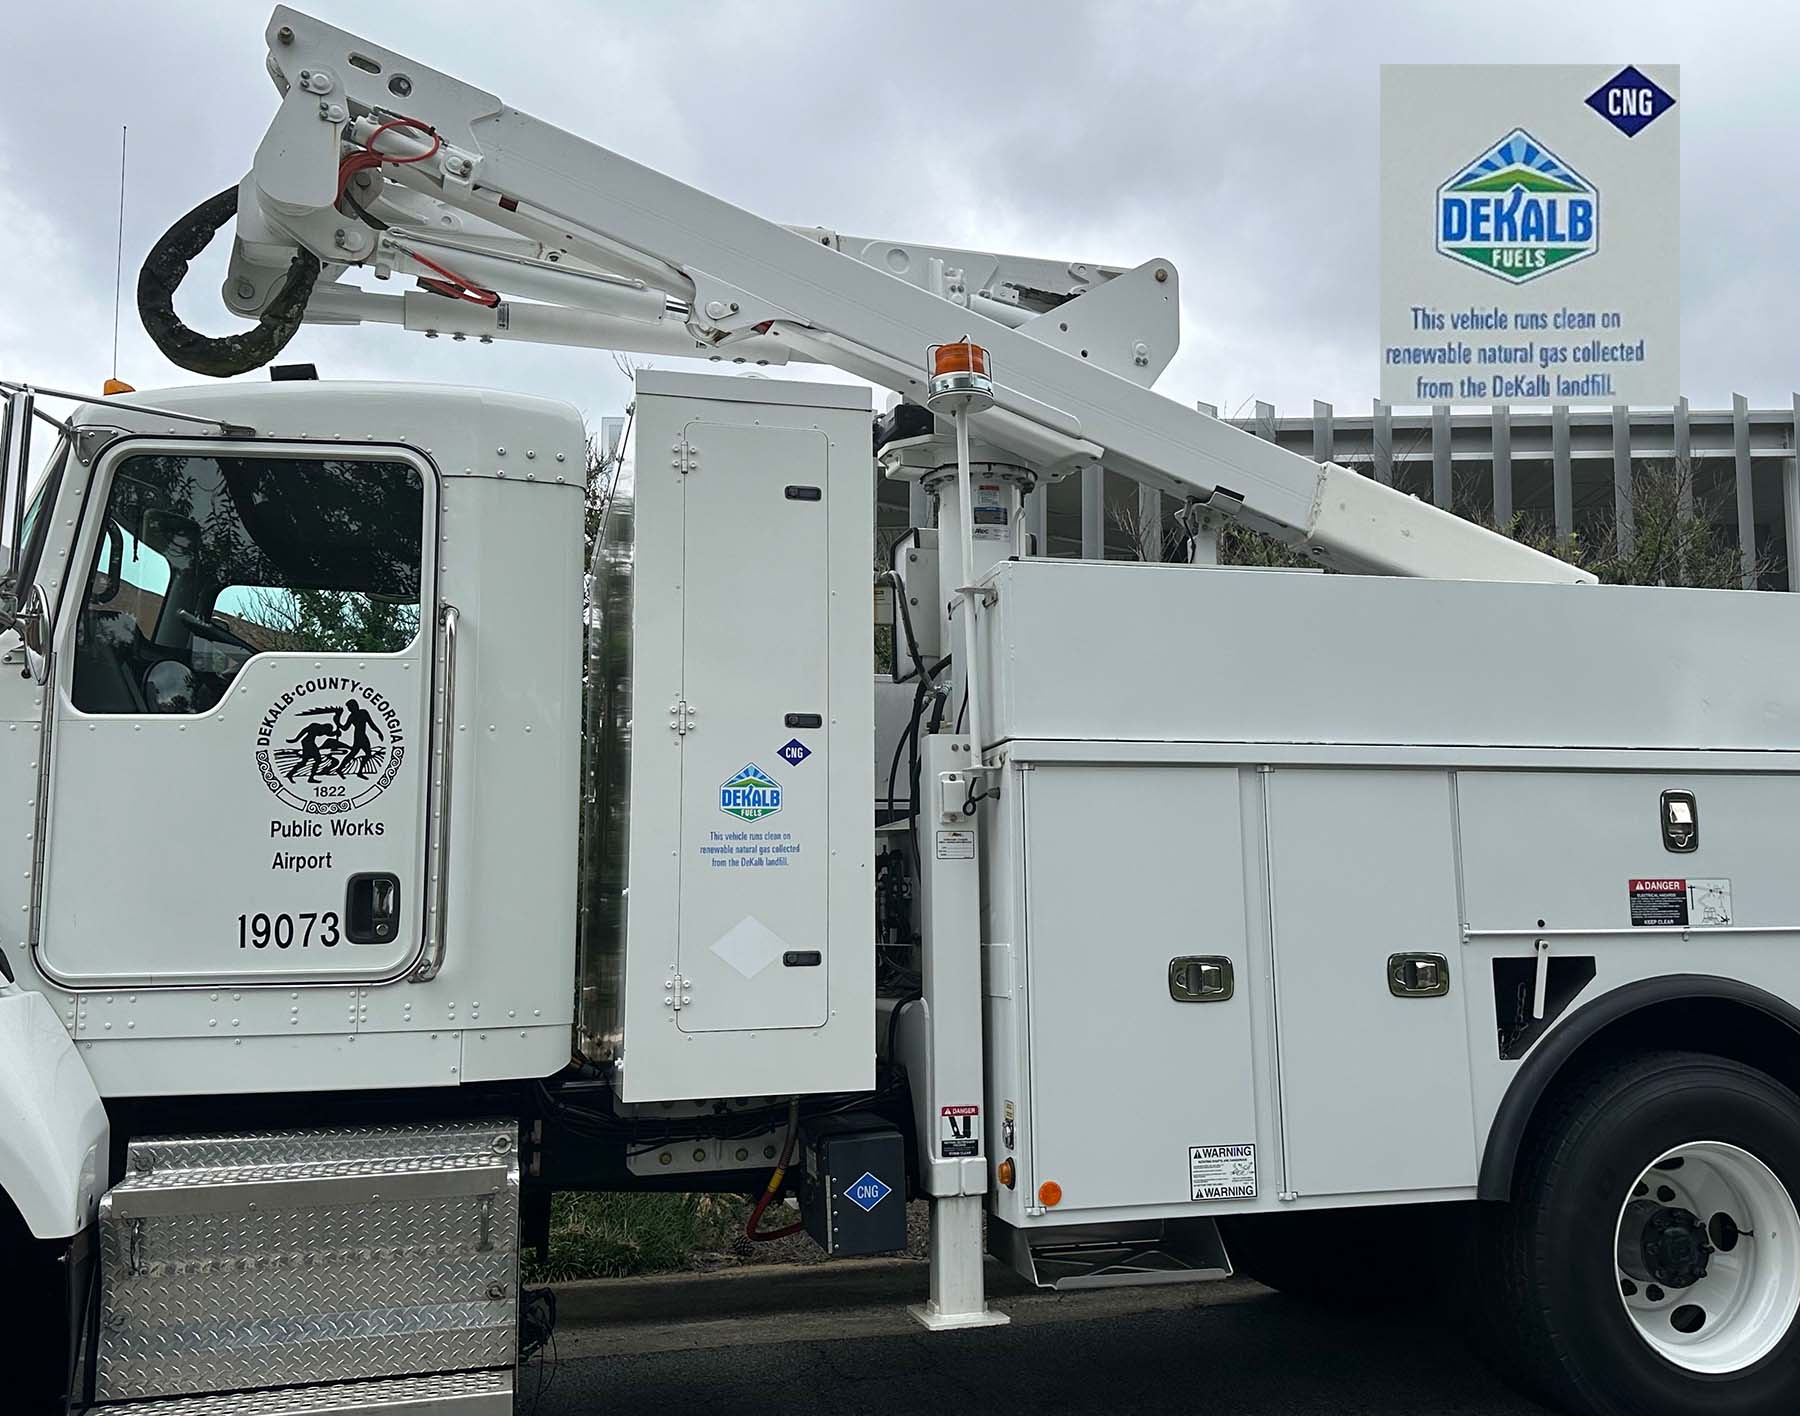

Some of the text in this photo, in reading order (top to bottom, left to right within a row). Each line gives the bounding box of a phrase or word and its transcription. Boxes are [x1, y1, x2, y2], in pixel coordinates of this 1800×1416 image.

[257, 677, 403, 746] DEKALB COUNTY GEORGIA
[785, 747, 804, 759] CNG
[313, 786, 346, 797] 1822
[722, 785, 780, 807] DEKALB
[740, 809, 762, 817] FUELS
[270, 818, 385, 838] Public Works
[710, 832, 723, 840] This
[724, 832, 748, 840] vehicle
[764, 832, 782, 840] clean
[700, 844, 800, 855] renewable natural gas collected
[272, 852, 332, 872] Airport
[712, 858, 727, 867] from
[728, 858, 740, 867] the
[741, 857, 764, 867] DeKalb
[1644, 881, 1680, 890] DANGER
[238, 912, 340, 948] 19073
[1202, 1146, 1252, 1158] WARNING
[857, 1184, 879, 1199] CNG
[1204, 1185, 1253, 1197] WARNING
